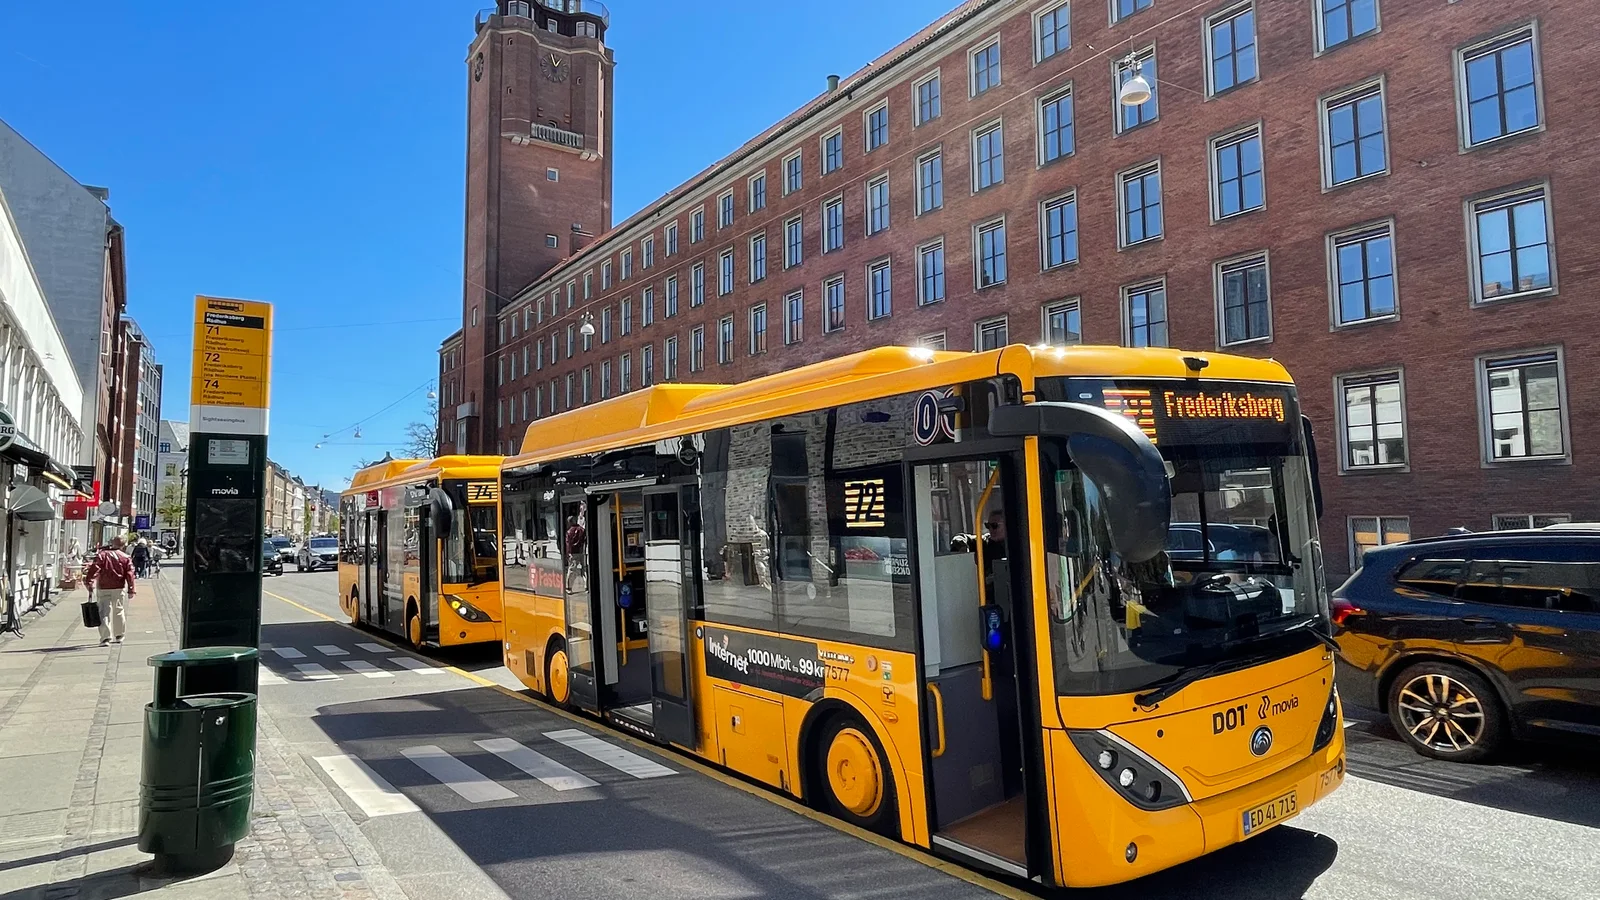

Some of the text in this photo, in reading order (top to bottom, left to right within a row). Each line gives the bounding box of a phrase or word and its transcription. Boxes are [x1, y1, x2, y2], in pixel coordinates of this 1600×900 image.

[206, 312, 244, 322] Frederiksberg
[206, 326, 220, 335] 71
[206, 335, 244, 343] Frederiksberg
[204, 352, 220, 362] 72
[204, 380, 219, 389] 74
[1164, 390, 1284, 422] Frederiksberg
[474, 484, 493, 500] 74
[856, 481, 878, 522] 72
[709, 636, 749, 675] Internet
[747, 648, 770, 667] 1000
[770, 651, 792, 672] Mbit
[799, 658, 814, 675] 99
[814, 659, 825, 678] kr
[825, 664, 850, 682] 7577
[1272, 694, 1299, 716] movia
[1212, 704, 1248, 735] DOT
[1320, 766, 1338, 789] 7577
[1250, 794, 1296, 828] ED 41 715
